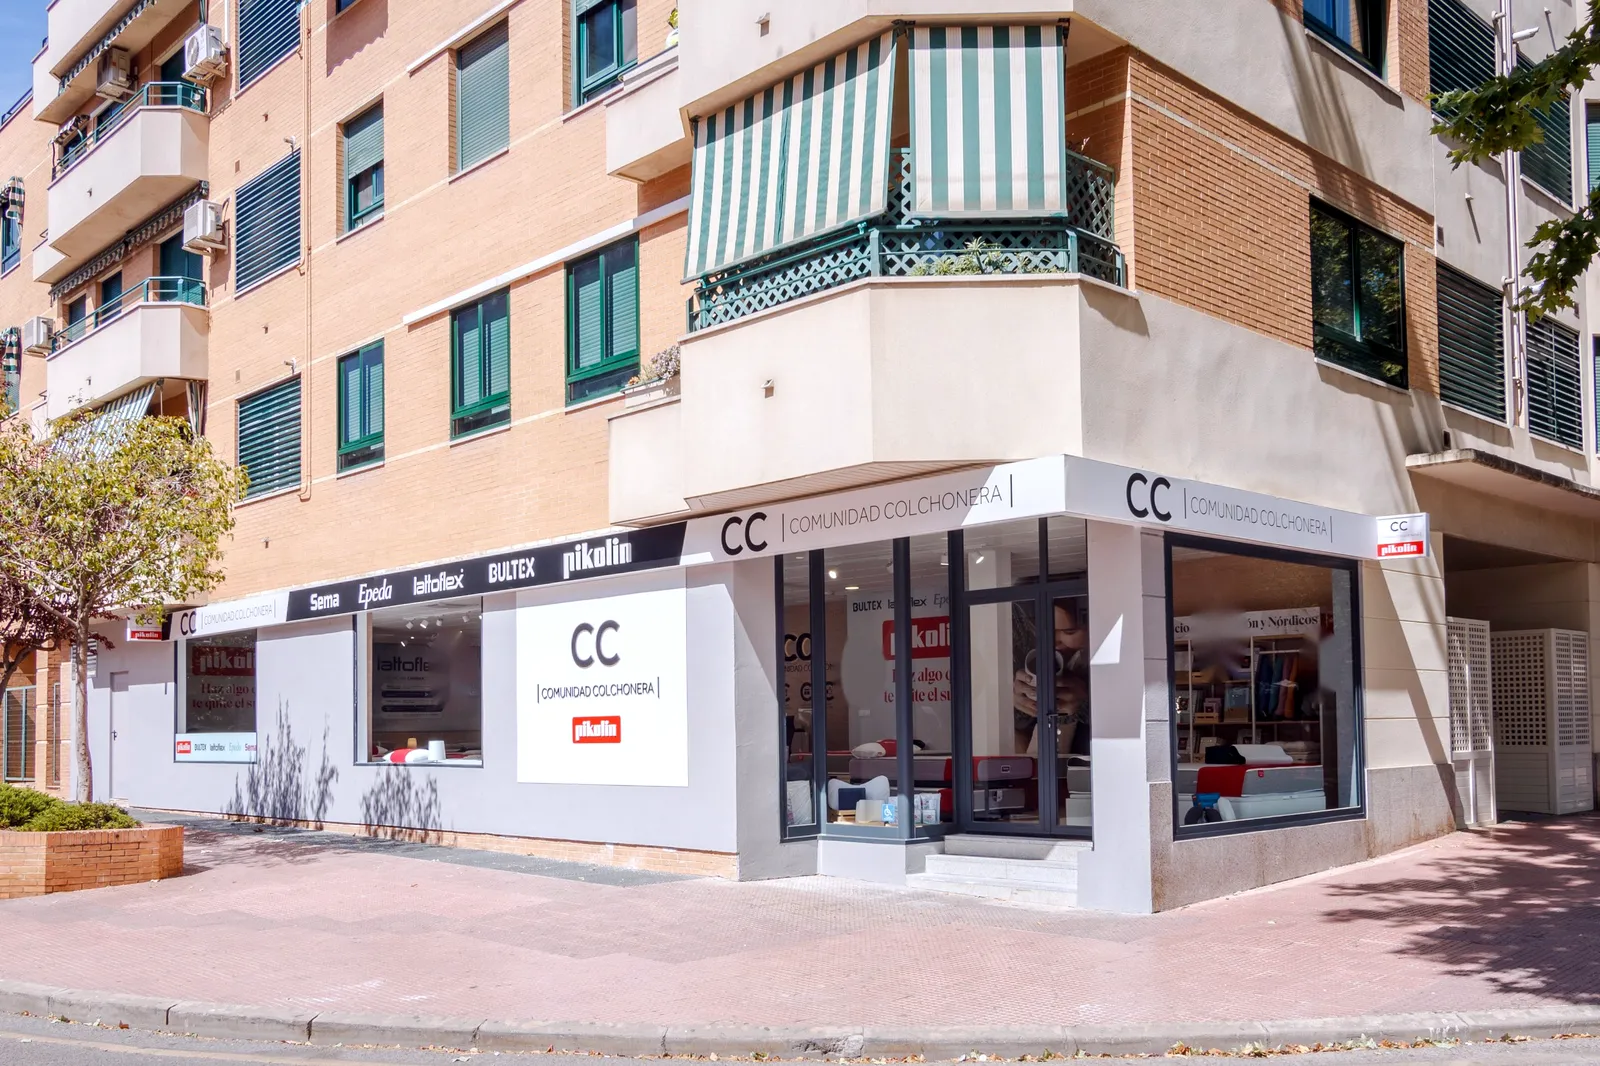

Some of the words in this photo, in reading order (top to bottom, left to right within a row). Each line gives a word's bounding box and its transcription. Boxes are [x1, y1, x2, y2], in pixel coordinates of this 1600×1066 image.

[1126, 472, 1172, 522] CC
[789, 505, 881, 534] COMUNIDAD
[883, 485, 1003, 519] COLCHONERA
[1190, 496, 1259, 524] COMUNIDAD
[1260, 509, 1328, 536] COLCHONERA
[721, 511, 768, 556] CC
[1390, 521, 1408, 532] CC
[1381, 543, 1418, 556] pikolin
[310, 593, 340, 611] Sema
[358, 578, 393, 609] Epeda
[413, 569, 464, 596] lattoflex
[488, 557, 536, 583] BULTEX
[563, 538, 632, 579] pikolin
[203, 610, 235, 626] COMUNIDAD
[235, 604, 273, 621] COLCHONERA
[852, 600, 882, 612] BULTEX
[180, 611, 197, 635] CC
[1260, 619, 1267, 630] y
[1268, 615, 1319, 628] Nórdicos
[134, 631, 159, 640] pikolin
[571, 619, 621, 669] CC
[917, 667, 943, 684] algo
[201, 683, 224, 694] Haz
[226, 683, 249, 696] algo
[541, 684, 592, 700] COMUNIDAD
[592, 682, 655, 697] COLCHONERA
[884, 691, 894, 703] te
[927, 687, 938, 702] el
[234, 697, 244, 708] el
[574, 720, 617, 741] pikolin
